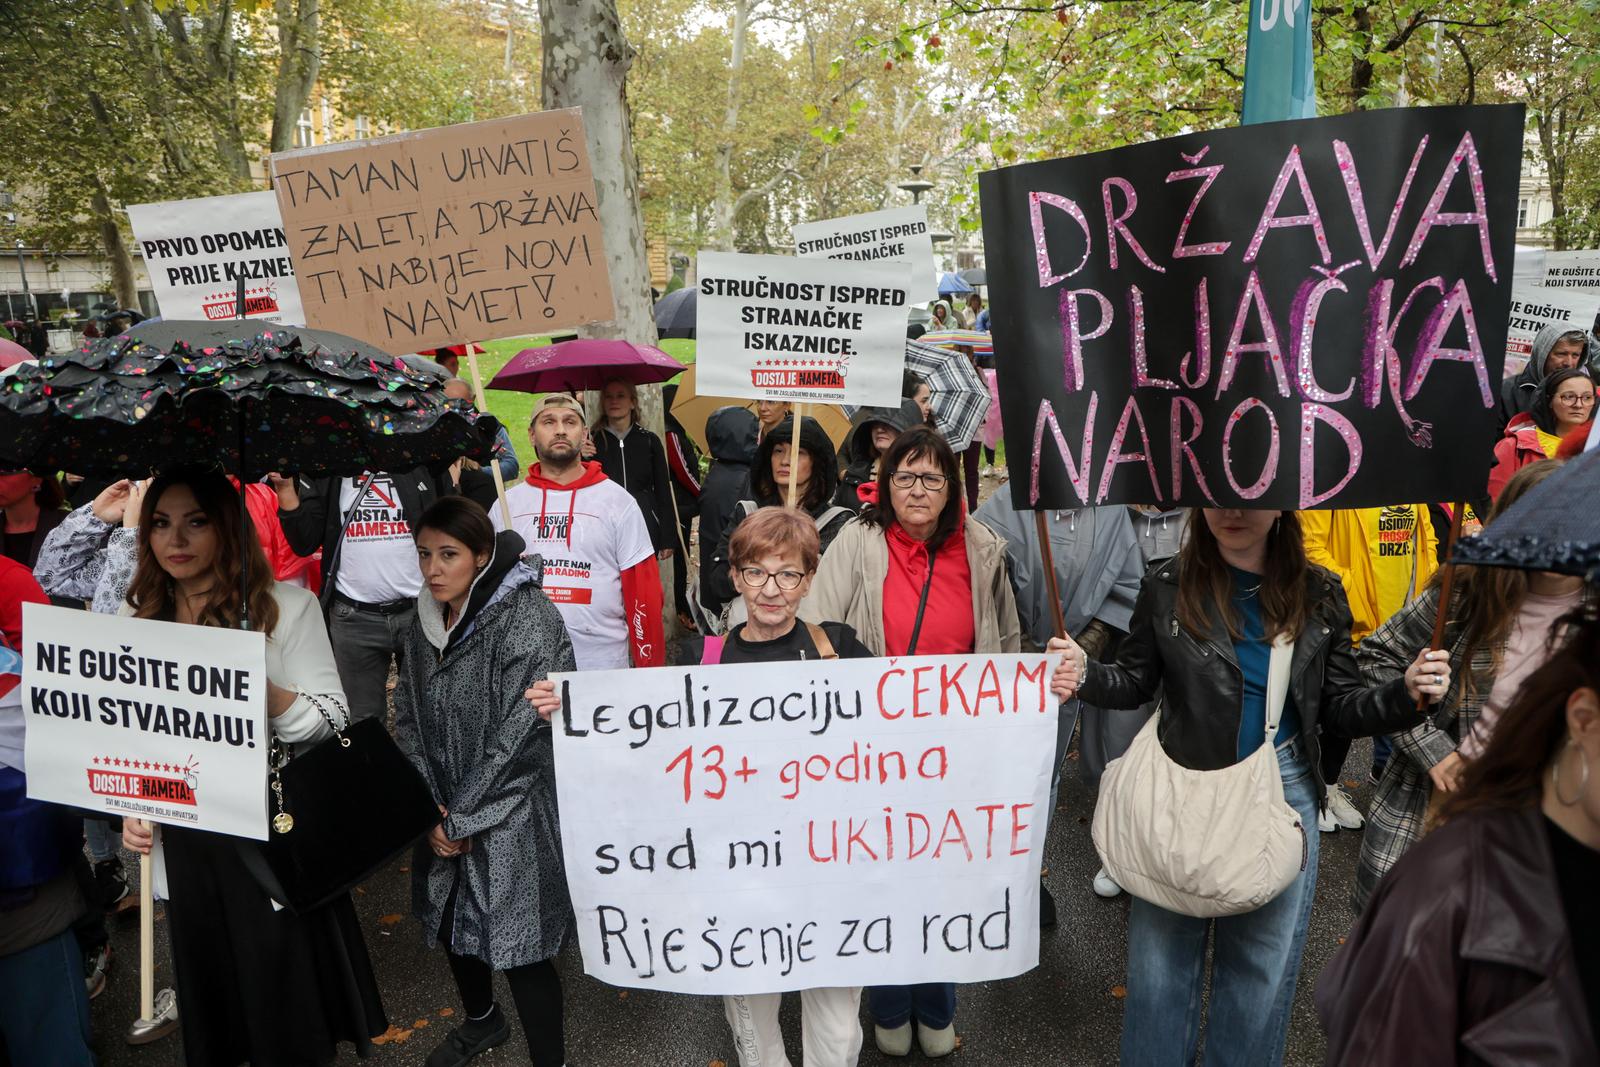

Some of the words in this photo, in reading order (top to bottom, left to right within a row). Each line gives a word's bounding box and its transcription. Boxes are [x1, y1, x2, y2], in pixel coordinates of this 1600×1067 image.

[275, 157, 420, 207] TAMAN
[441, 128, 579, 182] UHVATIŠ
[301, 211, 425, 259] ZALET,
[434, 207, 458, 239] A
[470, 189, 598, 236] DRŽAVA
[1028, 131, 1497, 288] DRŽAVA
[142, 236, 199, 260] PRVO
[798, 229, 877, 255] STRUČNOST
[880, 221, 927, 240] ISPRED
[828, 242, 905, 261] RANAČKE
[166, 263, 221, 287] PRIJE
[223, 256, 295, 282] KAZNE!
[306, 269, 348, 304] TI
[358, 249, 487, 295] NABIJE
[505, 234, 592, 271] NOVI
[1545, 279, 1565, 288] KOJI
[1548, 268, 1560, 276] NE
[1562, 266, 1594, 276] GUŠITE
[382, 274, 556, 339] NAMET!
[700, 275, 825, 302] STRUČNOST
[829, 285, 906, 307] ISPRED
[207, 303, 232, 319] DOSTA
[245, 298, 274, 313] AMETA!
[741, 305, 862, 331] STRANAČKE
[1523, 303, 1572, 321] GUŠITE
[744, 332, 858, 356] ISKAZNICE.
[1058, 259, 1495, 410] PLJAČKA
[755, 372, 785, 386] DOSTA
[786, 372, 797, 386] JE
[799, 372, 840, 386] NAMETA!
[1029, 390, 1363, 509] NAROD
[343, 509, 391, 522] OSTA
[533, 515, 574, 526] POSVJE
[537, 525, 568, 539] 10/10
[555, 567, 590, 579] RADIMO
[570, 560, 592, 570] NAM
[36, 642, 71, 675] NE
[79, 645, 180, 692] GUŠITE
[187, 664, 250, 702] ONE
[30, 686, 92, 722] KOJI
[98, 696, 256, 749] STVARAJU!
[561, 672, 862, 750] Legalizaciju
[876, 658, 1048, 722] ČEKAM
[93, 773, 127, 794] DOSTA
[128, 776, 140, 796] JE
[142, 778, 191, 801] NAMETA!
[665, 744, 758, 804] 13+
[779, 741, 948, 800] godina
[595, 827, 697, 875] sad
[728, 829, 783, 869] mi
[807, 803, 1034, 865] UKIDATE
[836, 915, 892, 959] za
[921, 886, 1010, 954] rad
